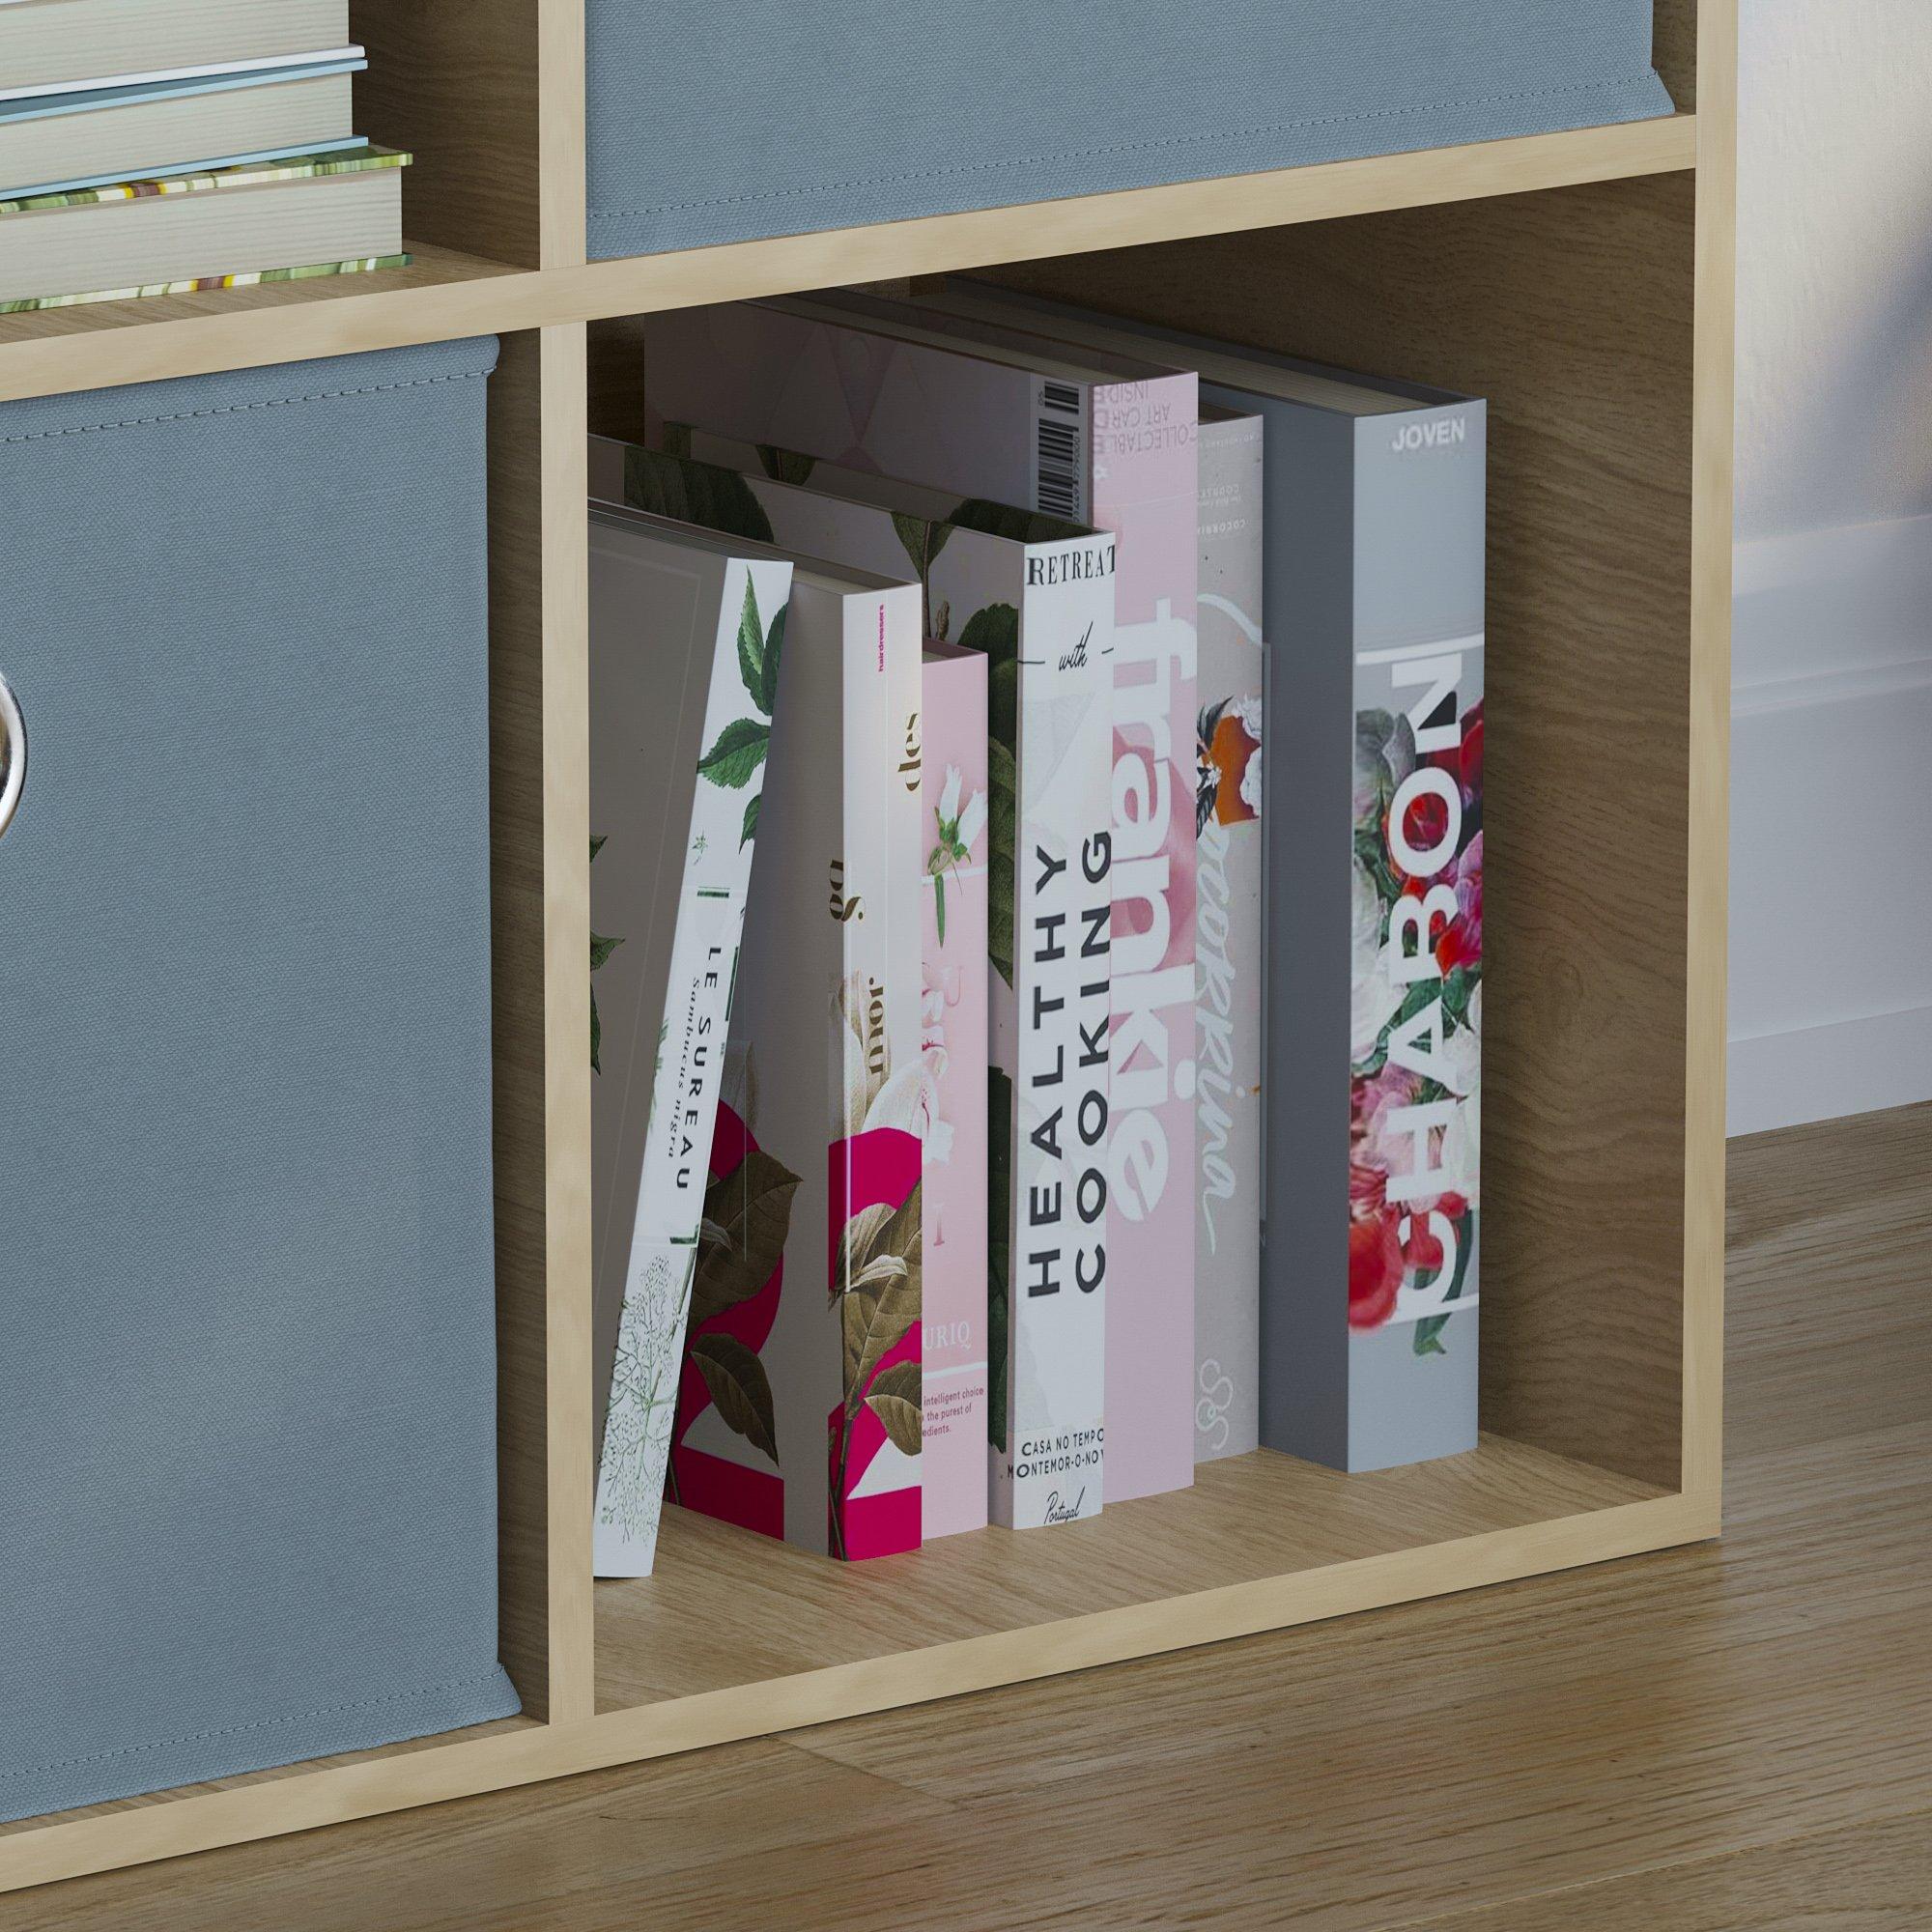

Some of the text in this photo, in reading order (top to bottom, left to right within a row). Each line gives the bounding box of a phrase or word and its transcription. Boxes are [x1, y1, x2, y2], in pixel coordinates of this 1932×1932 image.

[1145, 403, 1172, 422] ART
[1391, 416, 1465, 452] JOVEN
[1026, 545, 1115, 585] RETREAT
[1058, 621, 1094, 672] with
[1108, 597, 1197, 1223] frankie
[1385, 653, 1463, 1306] CHABON
[676, 947, 722, 1189] LE SUREAU
[1027, 845, 1066, 1297] HEALTHY
[1075, 831, 1112, 1293] COOKING
[668, 1099, 681, 1158] nigra
[923, 1386, 984, 1406] intelligent choice
[926, 1410, 939, 1422] the
[941, 1406, 963, 1421] purest
[964, 1403, 972, 1414] of
[1021, 1438, 1052, 1456] CASA
[1056, 1435, 1069, 1451] NO
[1044, 1486, 1085, 1524] Portugal
